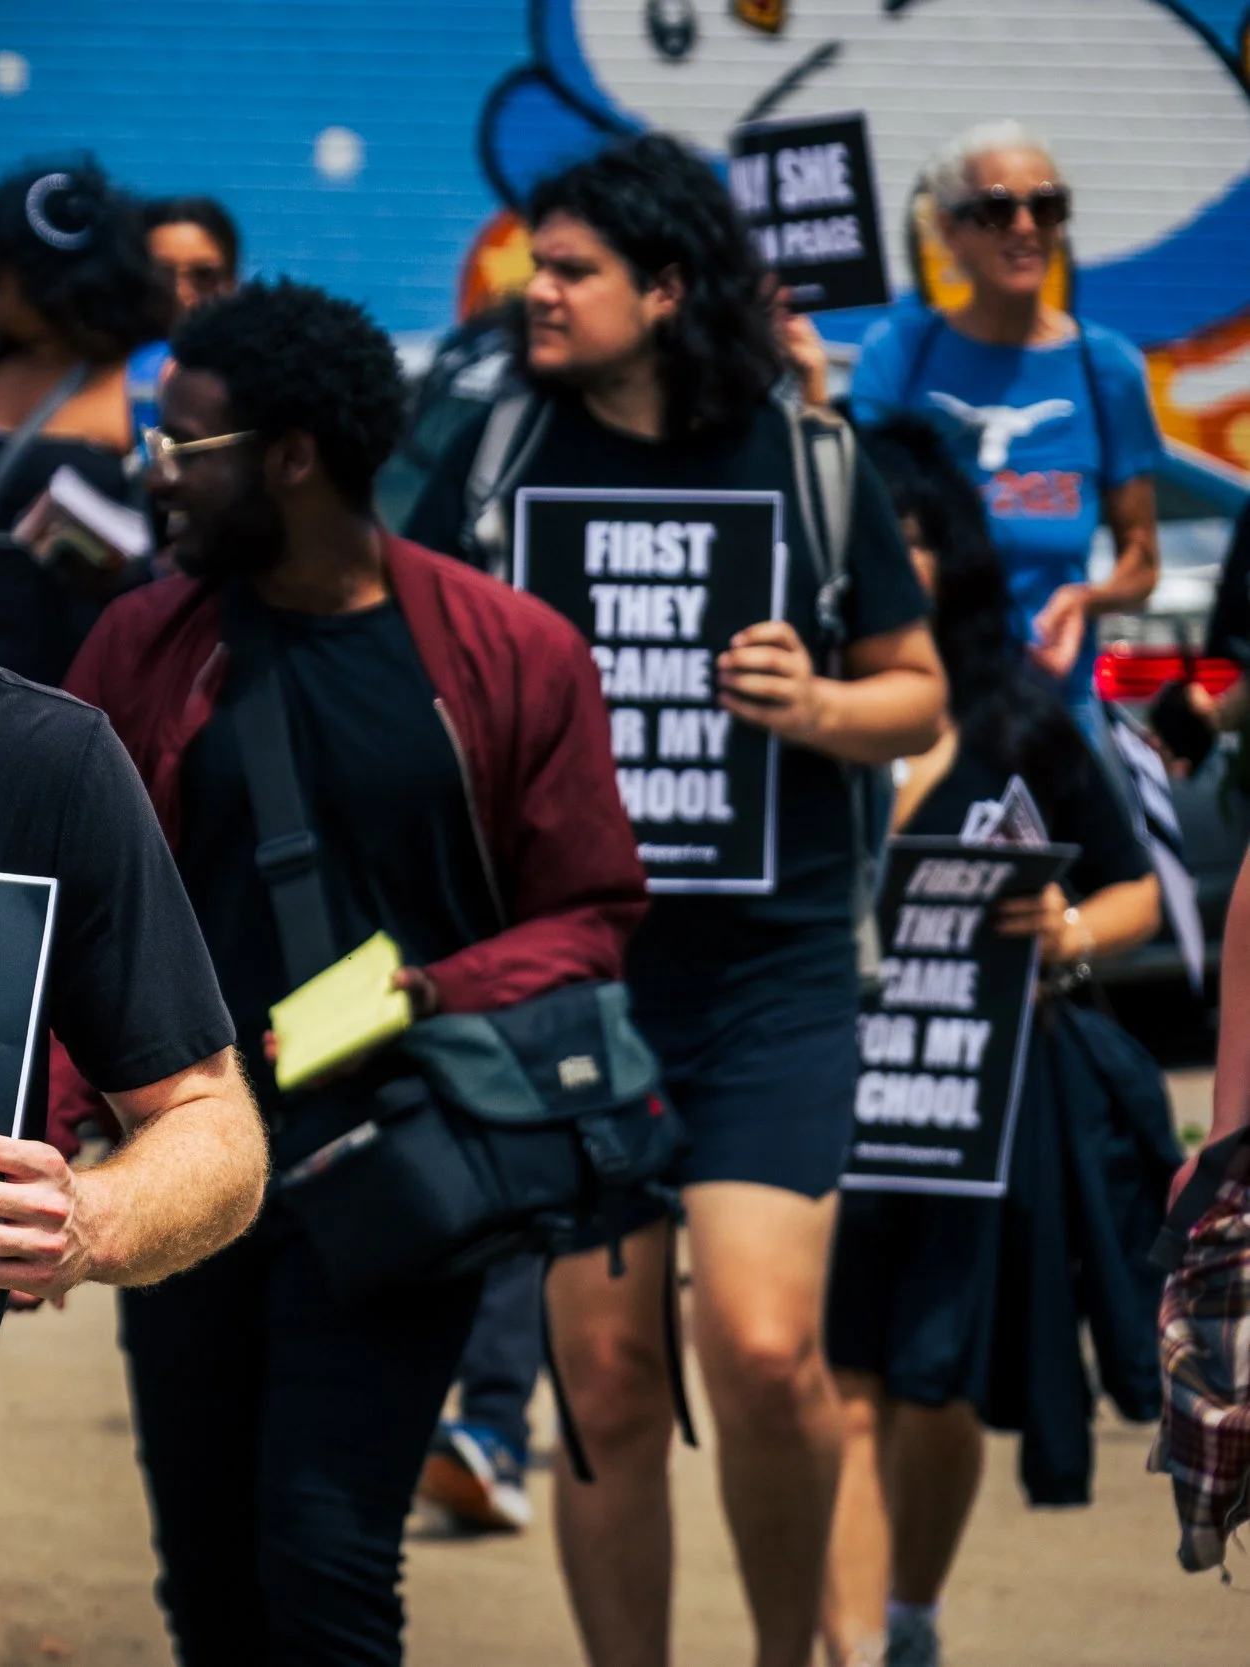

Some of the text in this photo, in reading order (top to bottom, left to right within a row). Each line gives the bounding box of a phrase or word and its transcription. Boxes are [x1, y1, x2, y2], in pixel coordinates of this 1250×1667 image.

[584, 521, 717, 578] FIRST
[590, 583, 708, 641] THEY
[656, 707, 733, 763] MY
[904, 857, 1014, 901] FIRST
[922, 1016, 992, 1071] MY
